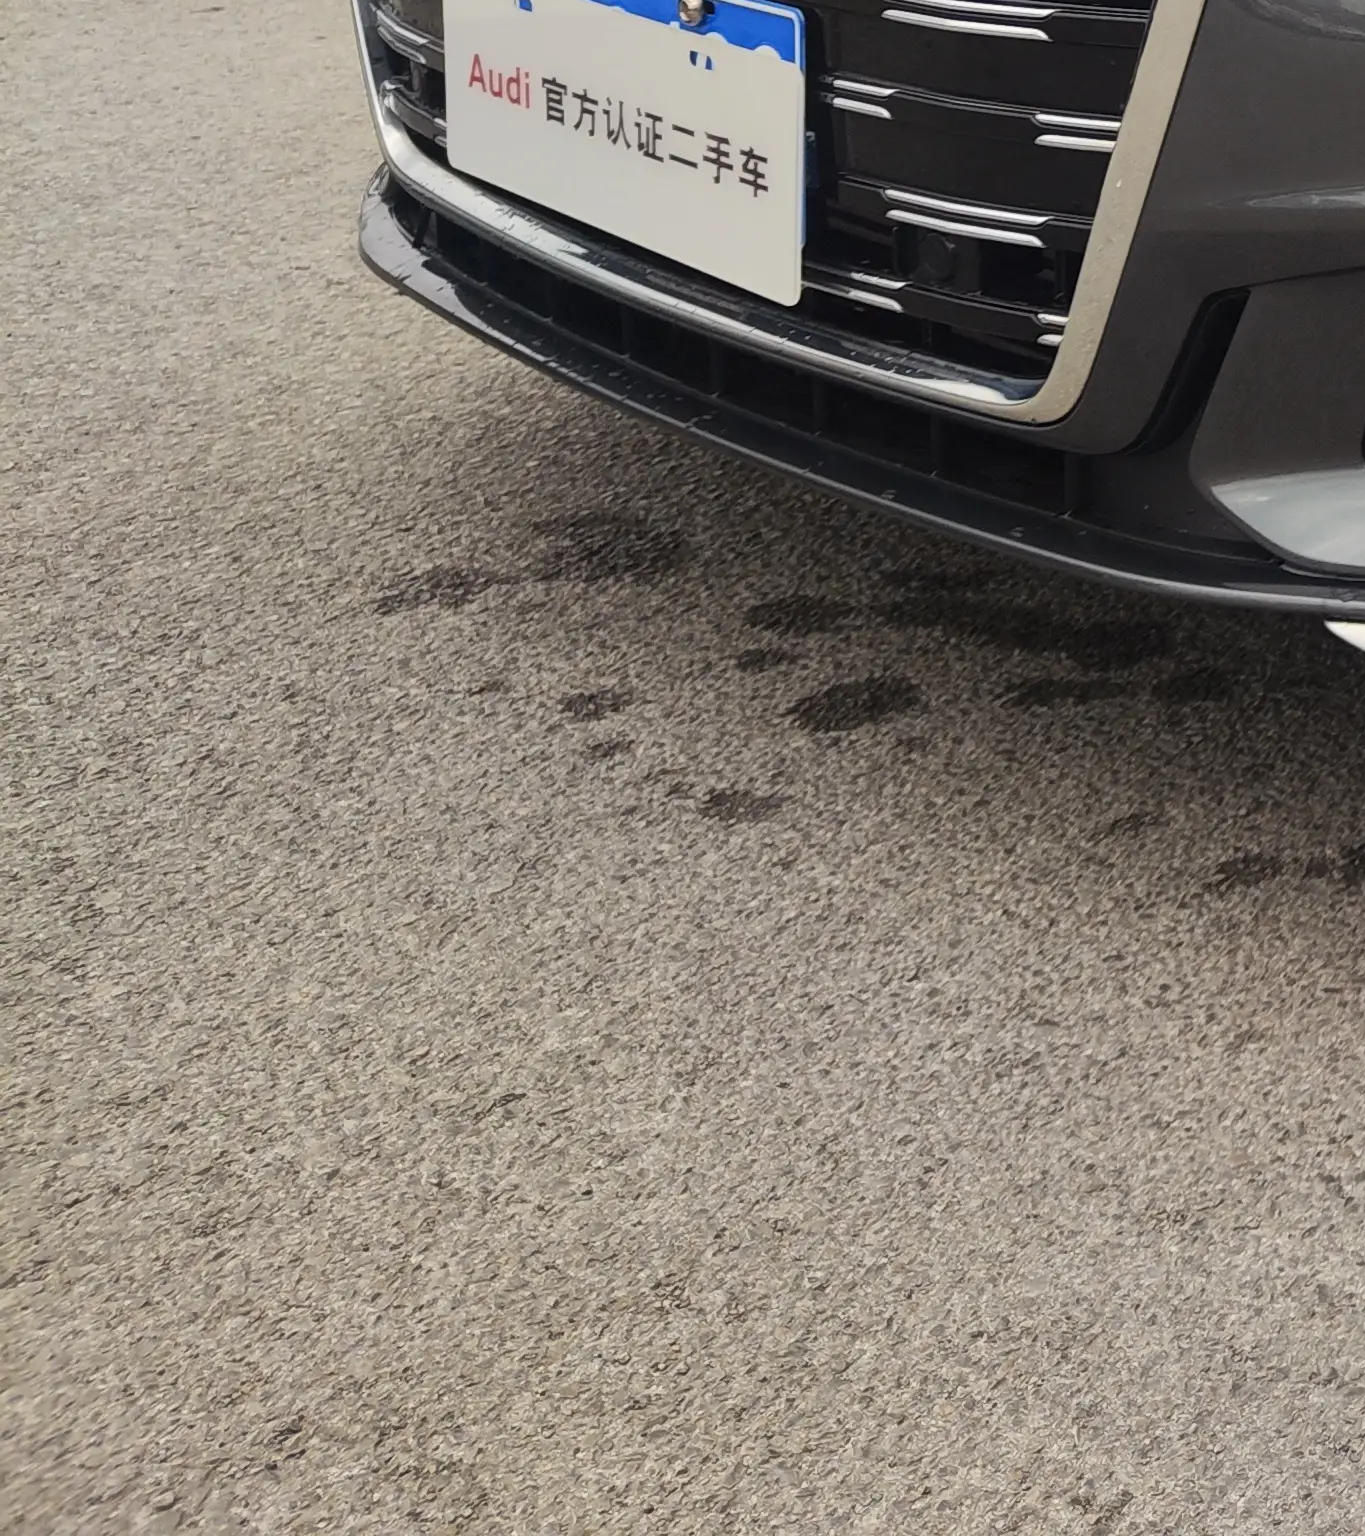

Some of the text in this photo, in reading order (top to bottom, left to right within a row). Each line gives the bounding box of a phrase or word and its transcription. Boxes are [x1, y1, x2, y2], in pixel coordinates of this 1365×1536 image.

[468, 53, 769, 198] Audi 官方认证二手车
